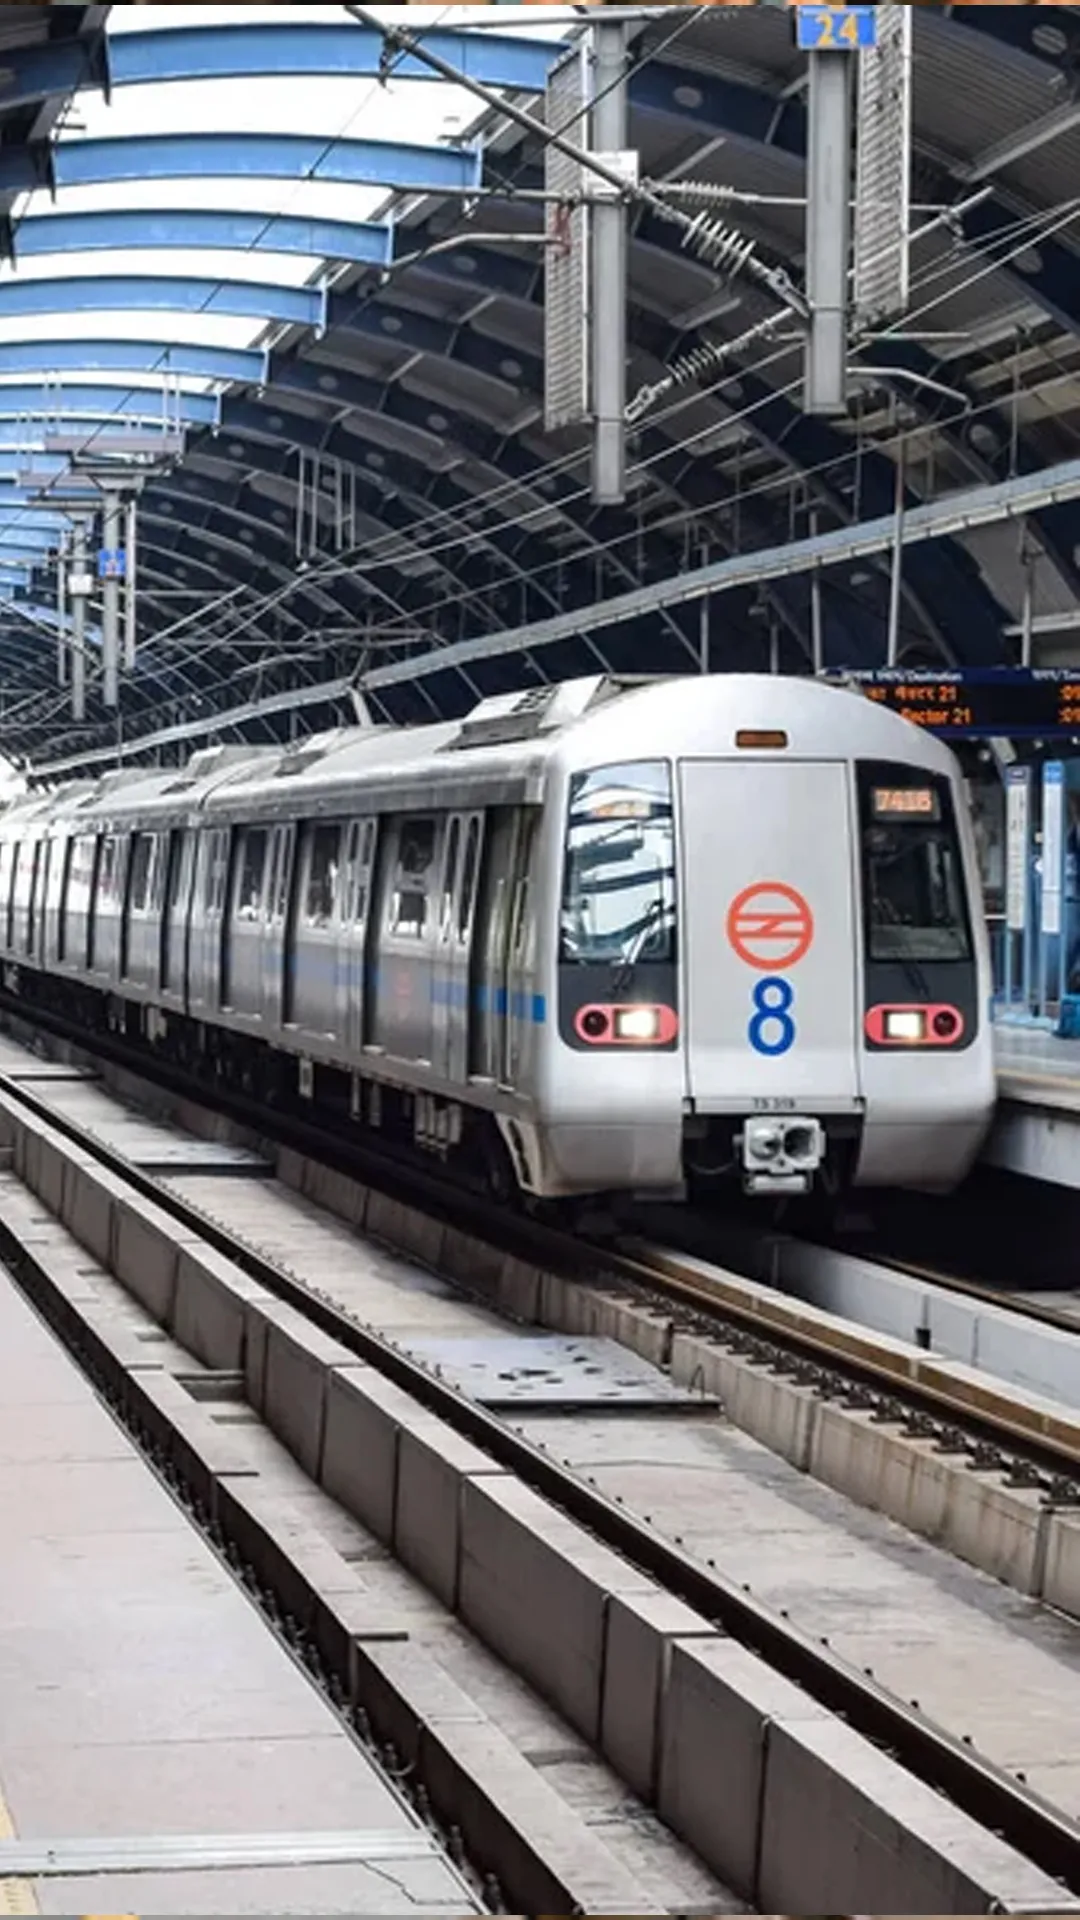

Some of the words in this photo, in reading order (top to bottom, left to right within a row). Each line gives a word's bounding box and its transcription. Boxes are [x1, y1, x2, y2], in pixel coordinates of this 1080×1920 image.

[815, 12, 859, 47] 24
[938, 685, 958, 702] 21
[952, 708, 971, 725] 21
[748, 976, 797, 1057] 8
